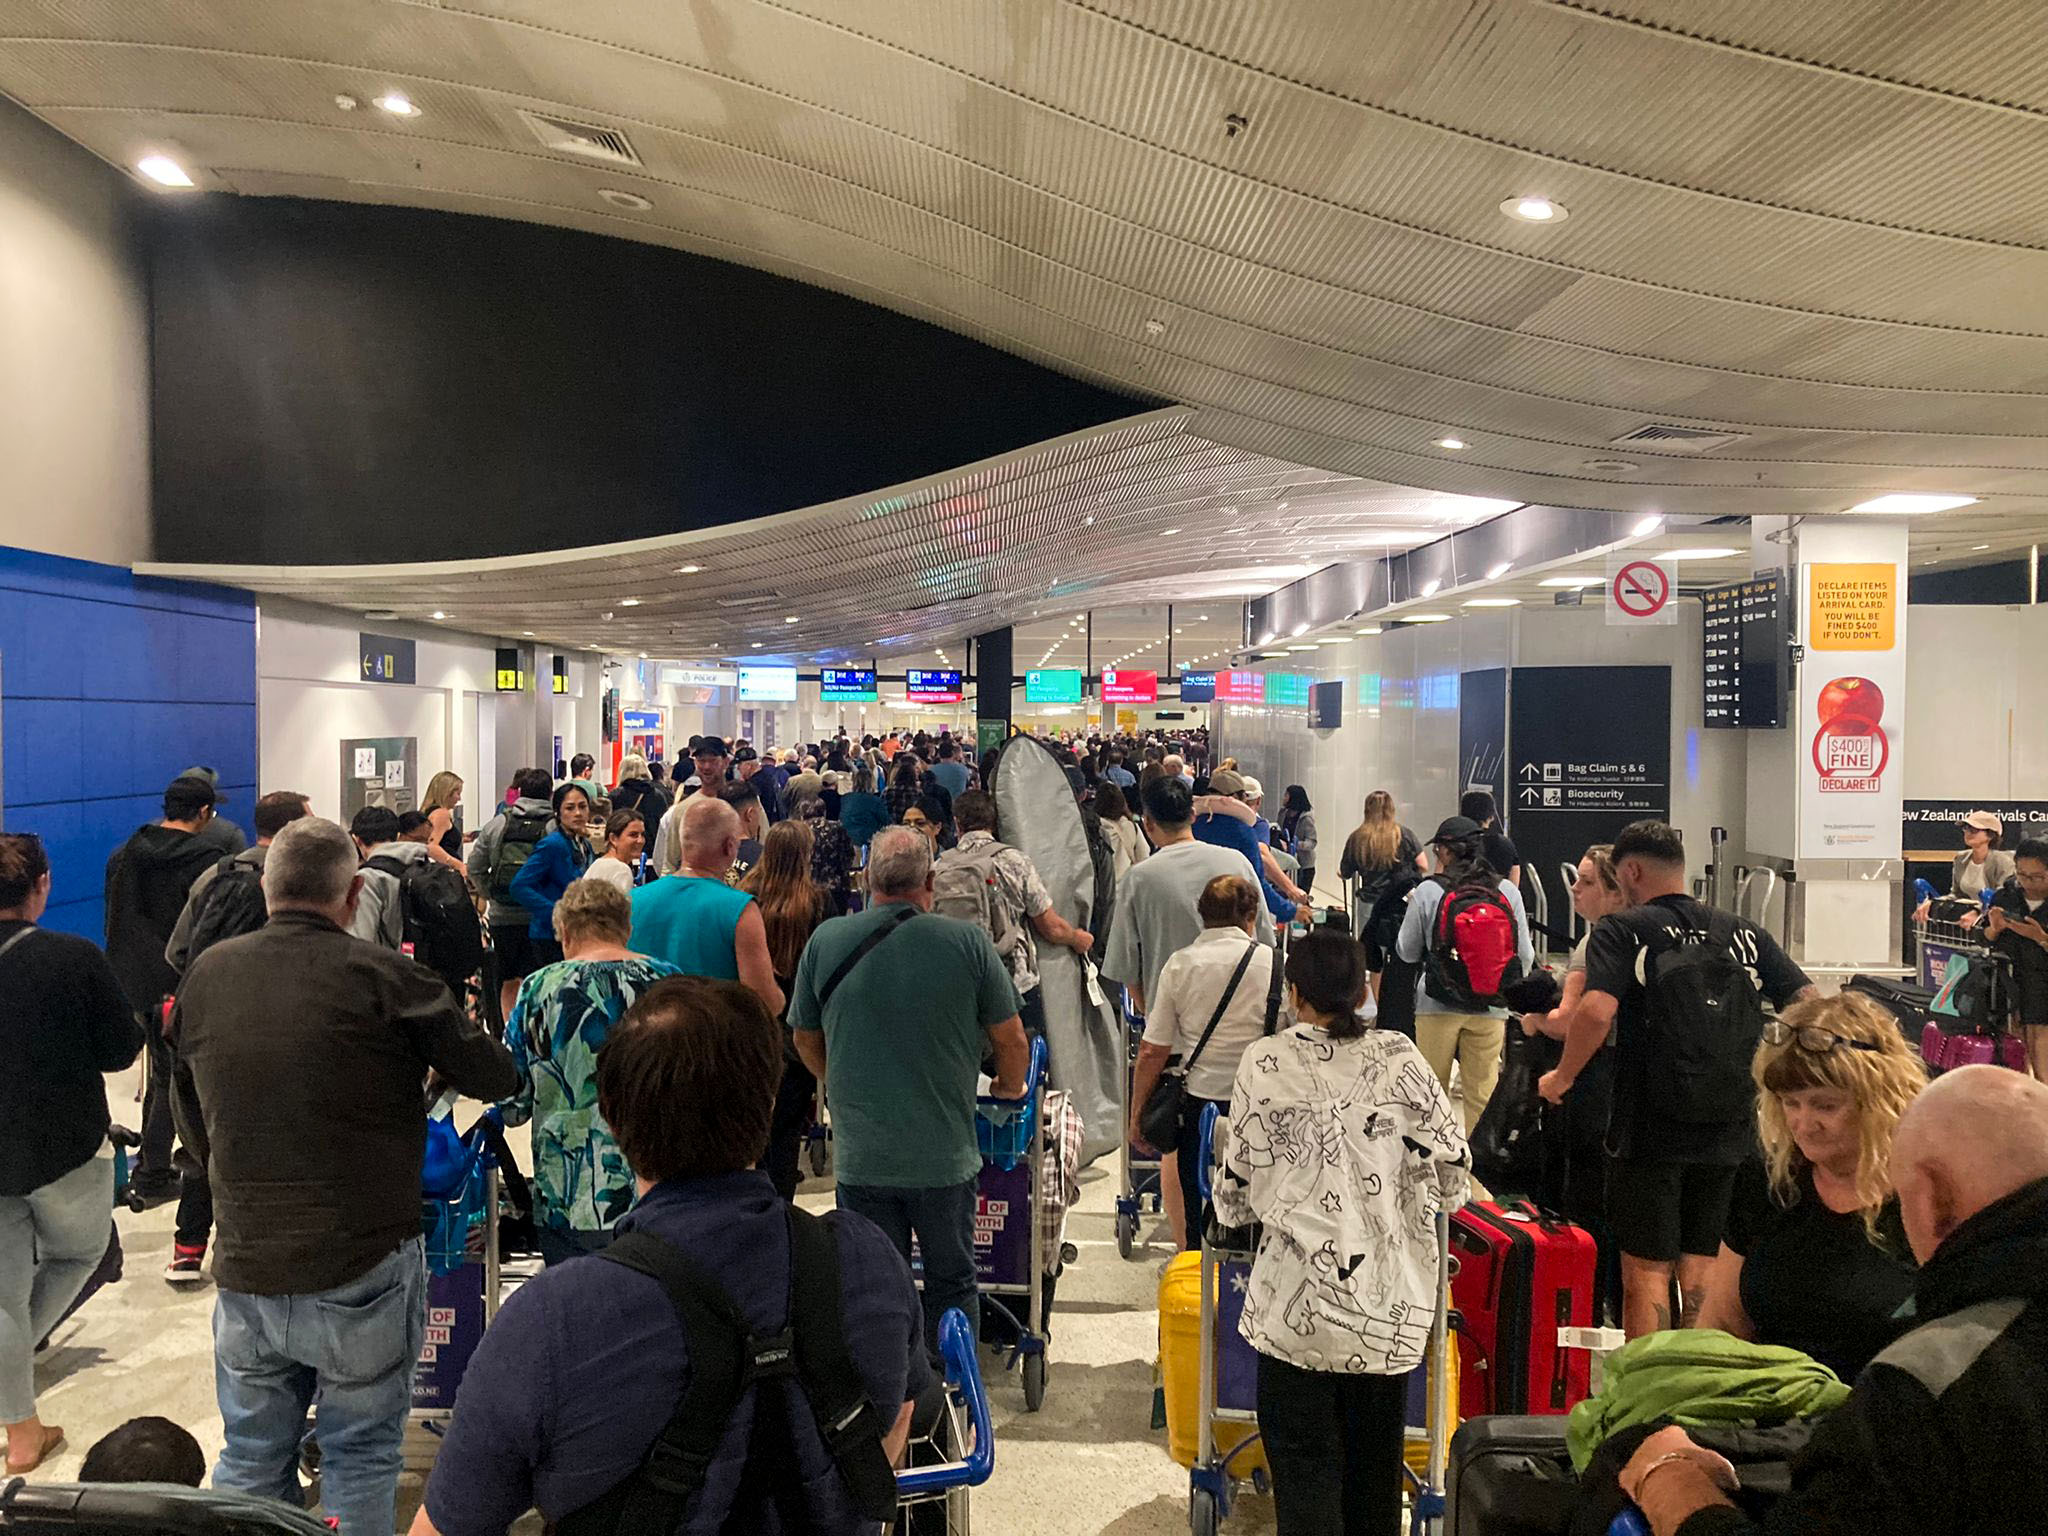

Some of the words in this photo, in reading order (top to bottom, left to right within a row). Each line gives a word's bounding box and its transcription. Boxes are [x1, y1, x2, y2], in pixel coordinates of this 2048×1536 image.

[1818, 582, 1858, 590] DECLARE
[1860, 582, 1887, 590] ITEMS
[1827, 622, 1854, 630] FINED
[1855, 622, 1877, 630] $400
[1831, 739, 1862, 753] $400
[1831, 754, 1869, 767] FINE
[1568, 764, 1587, 775] Bag
[1589, 763, 1618, 772] Claim
[1620, 765, 1627, 774] 5
[1628, 764, 1636, 772] &
[1638, 764, 1645, 772] 6
[1822, 779, 1865, 790] DECLARE
[1867, 779, 1877, 790] IT
[1568, 789, 1624, 800] Biosecurity
[1901, 811, 1919, 821] ew
[1920, 808, 1974, 821] Zealand
[990, 1203, 1006, 1212] OF
[432, 1311, 453, 1322] OF
